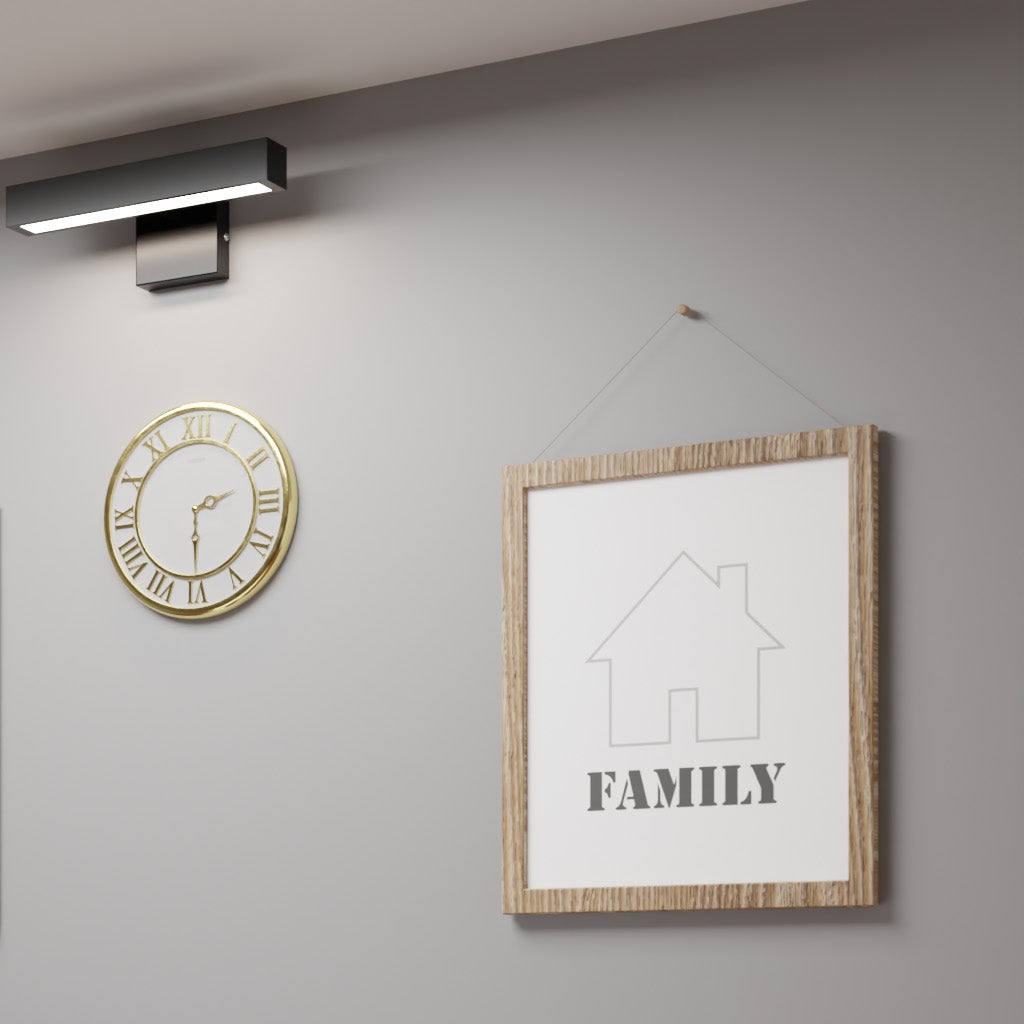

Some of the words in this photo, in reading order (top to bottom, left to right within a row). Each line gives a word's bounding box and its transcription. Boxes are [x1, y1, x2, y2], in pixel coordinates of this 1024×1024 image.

[182, 414, 211, 440] XII
[224, 420, 237, 444] I
[143, 430, 172, 462] XI
[247, 449, 270, 471] II
[121, 471, 144, 490] X
[259, 488, 279, 515] III
[115, 506, 134, 531] IX
[249, 528, 274, 557] IV
[118, 536, 148, 579] VIII
[146, 570, 175, 603] VII
[228, 567, 245, 589] V
[187, 579, 208, 604] VI
[586, 763, 786, 811] FAMILY
